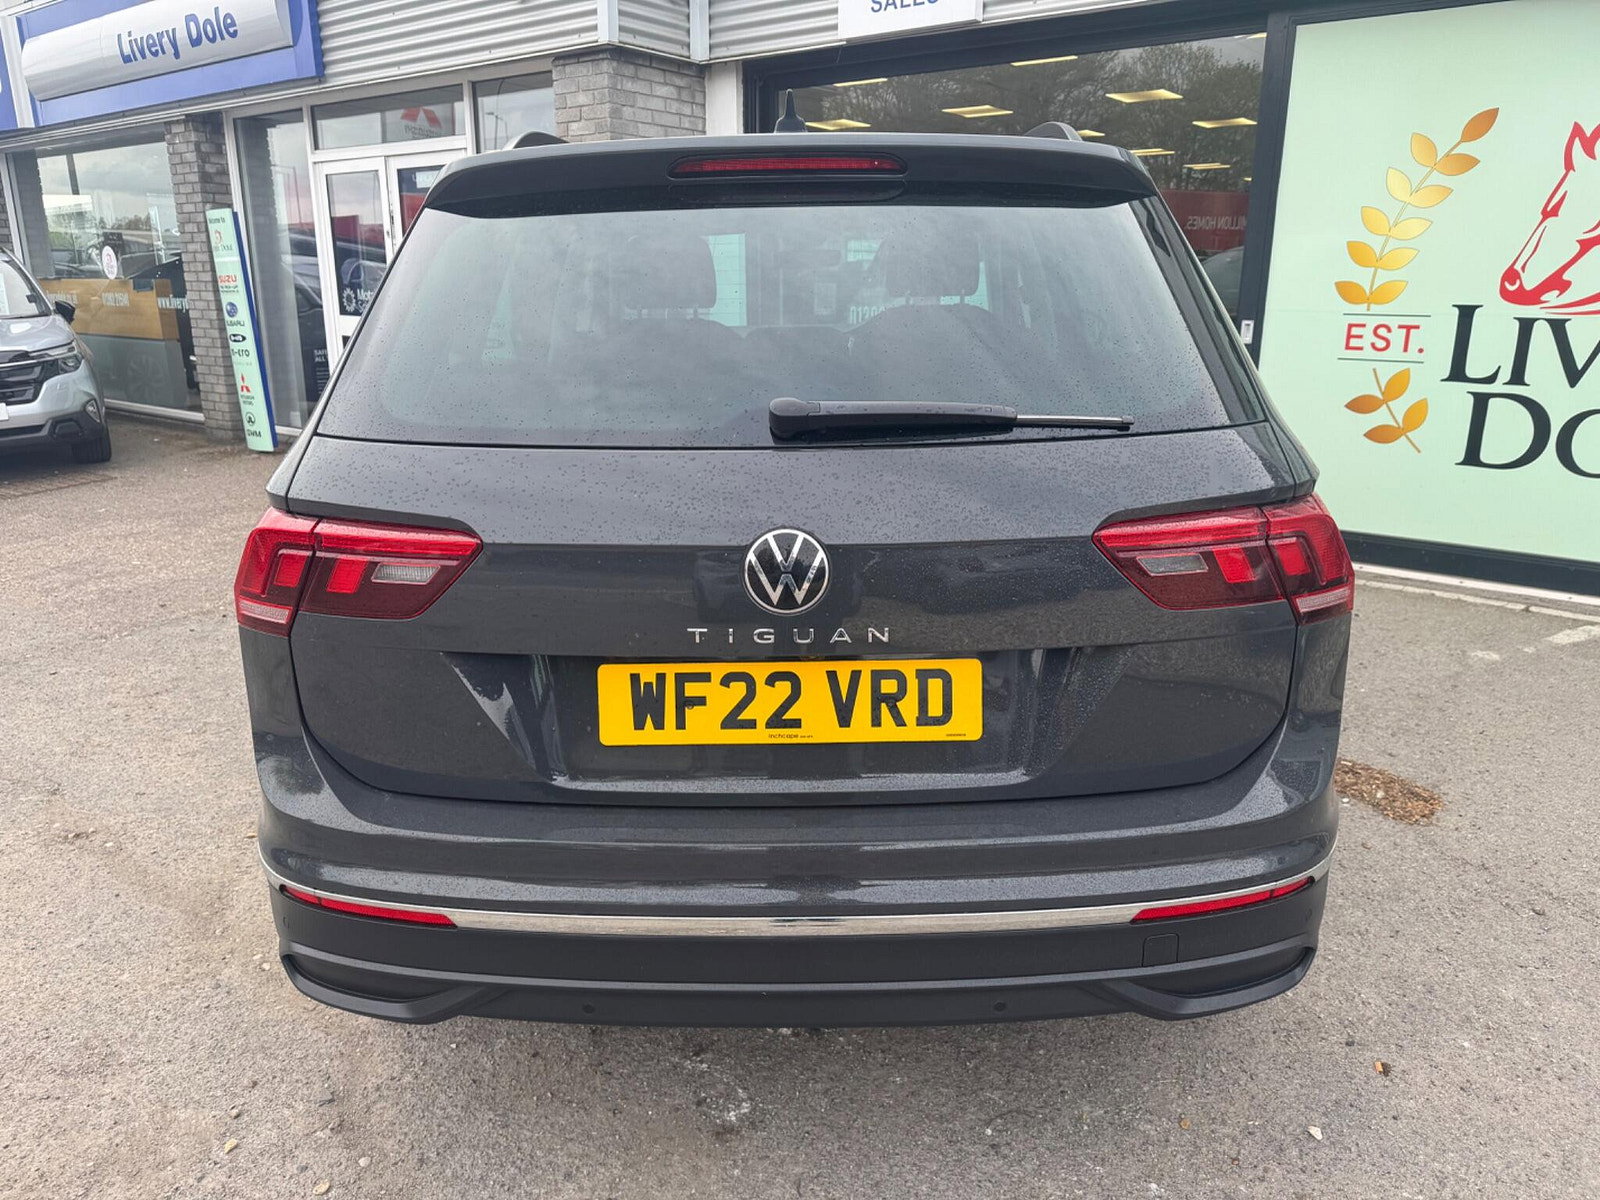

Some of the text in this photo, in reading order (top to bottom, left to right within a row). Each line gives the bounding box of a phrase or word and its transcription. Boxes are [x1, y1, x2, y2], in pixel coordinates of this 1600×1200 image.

[117, 6, 238, 64] Livery Dole
[871, 0, 938, 13] SAL
[1343, 322, 1426, 355] EST.
[1440, 303, 1600, 389] LIV
[1454, 390, 1600, 480] DO
[686, 626, 891, 644] TIGUAN
[629, 668, 953, 731] WF22 VRD
